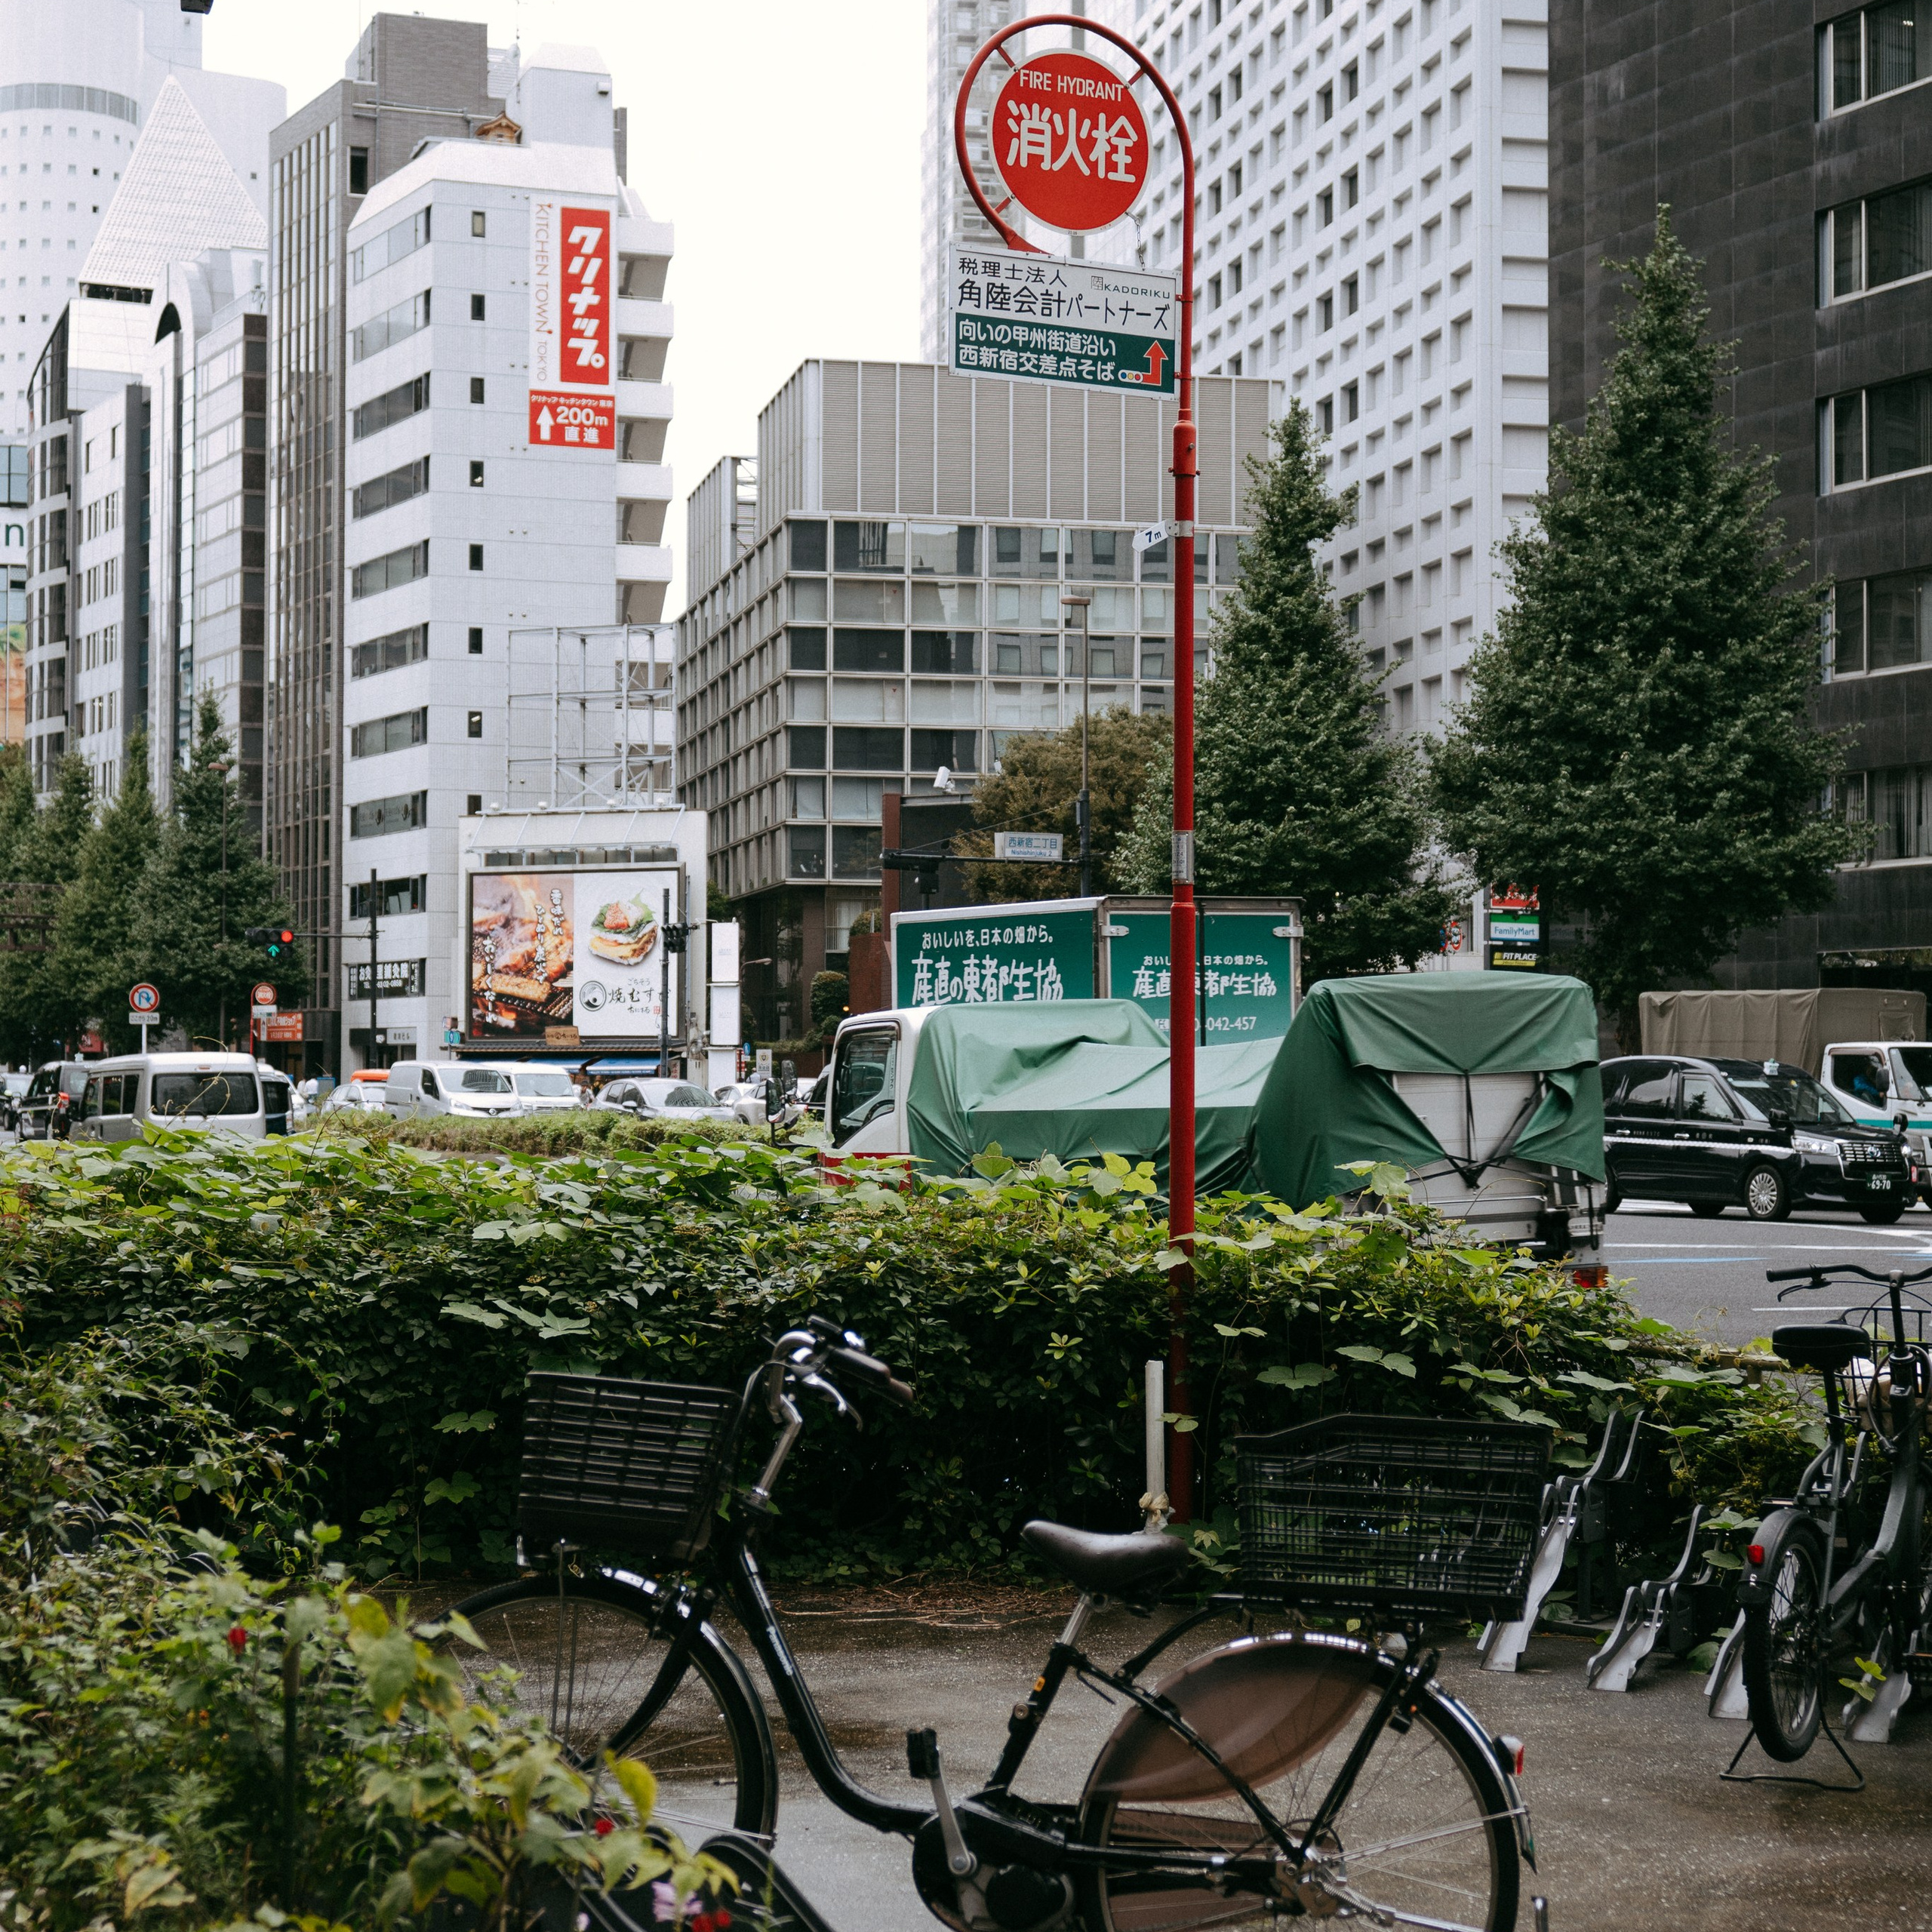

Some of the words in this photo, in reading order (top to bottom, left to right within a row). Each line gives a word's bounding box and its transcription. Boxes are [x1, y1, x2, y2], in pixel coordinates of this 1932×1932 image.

[1020, 69, 1052, 91] FIRE
[1057, 74, 1124, 102] HYDRANT
[1006, 99, 1138, 183] 消火栓
[535, 203, 552, 276] KITCHEN
[958, 257, 1068, 288] 税理士法人
[535, 281, 552, 334] TOWN
[568, 225, 606, 369] クリナップ
[958, 278, 1171, 331] 角陸会計パートナーズ
[1104, 283, 1171, 300] KADORIKU
[958, 318, 1116, 357] 向いの甲州街道沿い
[536, 340, 547, 382] TOKYO
[958, 343, 1115, 381] 西新宿交差点そば
[531, 395, 558, 403] クリナップ
[559, 397, 598, 407] キッチンタウン
[556, 405, 608, 426] 200m
[565, 426, 600, 444] 直進
[1008, 836, 1057, 849] 西新宿二丁目
[1011, 849, 1047, 857] Nishishinjuku
[921, 924, 1054, 949] おいしいを、日本の畑から。
[1494, 926, 1535, 937] FamilyMart
[1514, 952, 1537, 961] PLACE
[911, 950, 1064, 1008] 産直の東都生協
[765, 1625, 794, 1676] Panasonic
